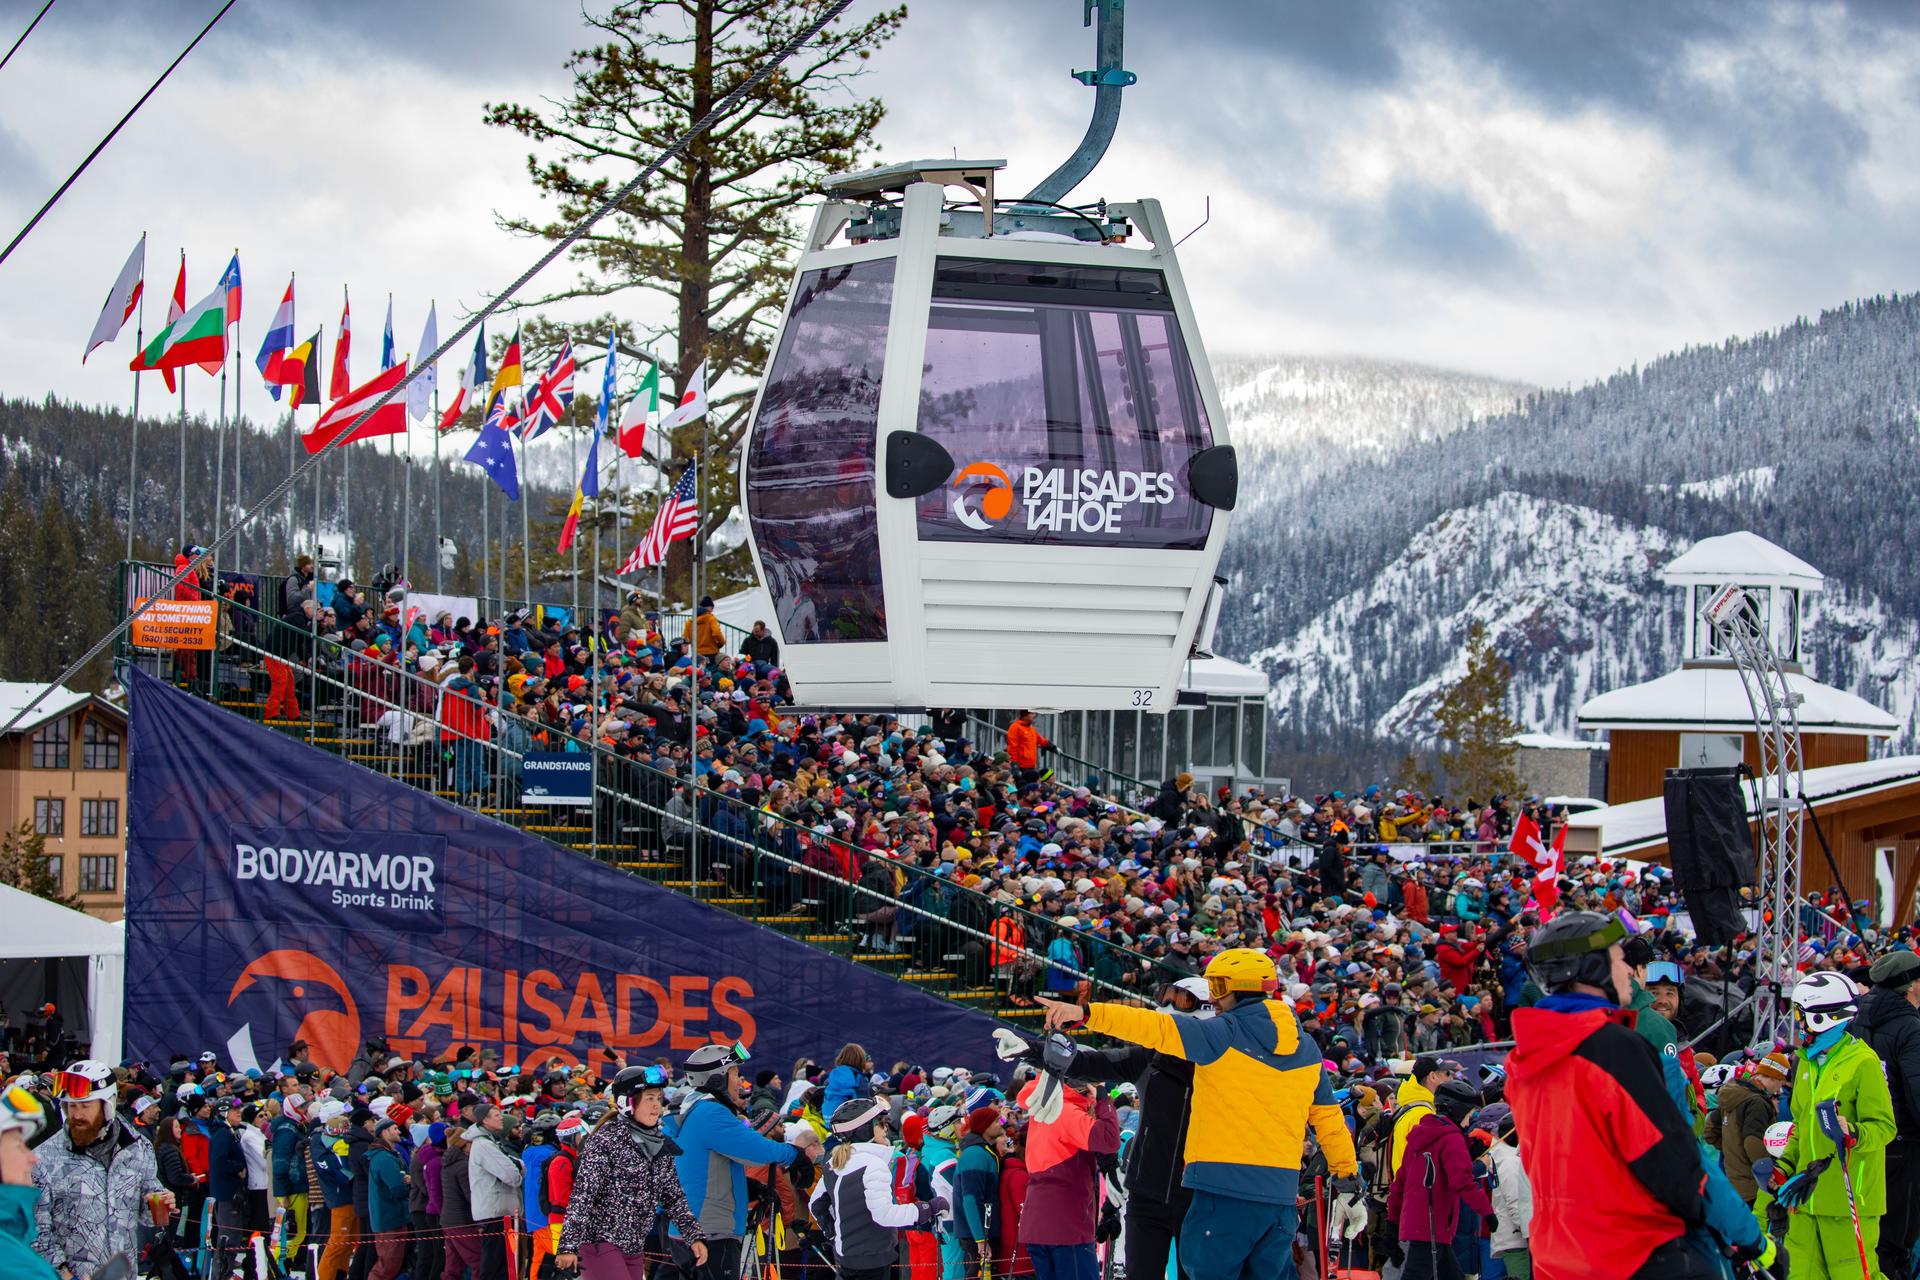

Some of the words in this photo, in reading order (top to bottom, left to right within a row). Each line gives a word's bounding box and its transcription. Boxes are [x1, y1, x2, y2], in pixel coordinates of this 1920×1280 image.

[1023, 467, 1174, 505] PALISADES
[1023, 500, 1122, 533] TAHOE
[156, 613, 211, 624] SOMETHING
[143, 625, 162, 634] CALL
[164, 626, 204, 635] SECURITY
[1132, 689, 1152, 706] 32
[524, 761, 590, 771] GRANDSTANDS
[236, 844, 435, 893] BODYARMOR
[332, 889, 385, 909] Sports
[391, 892, 434, 911] Drink
[385, 964, 757, 1051] PALISADES
